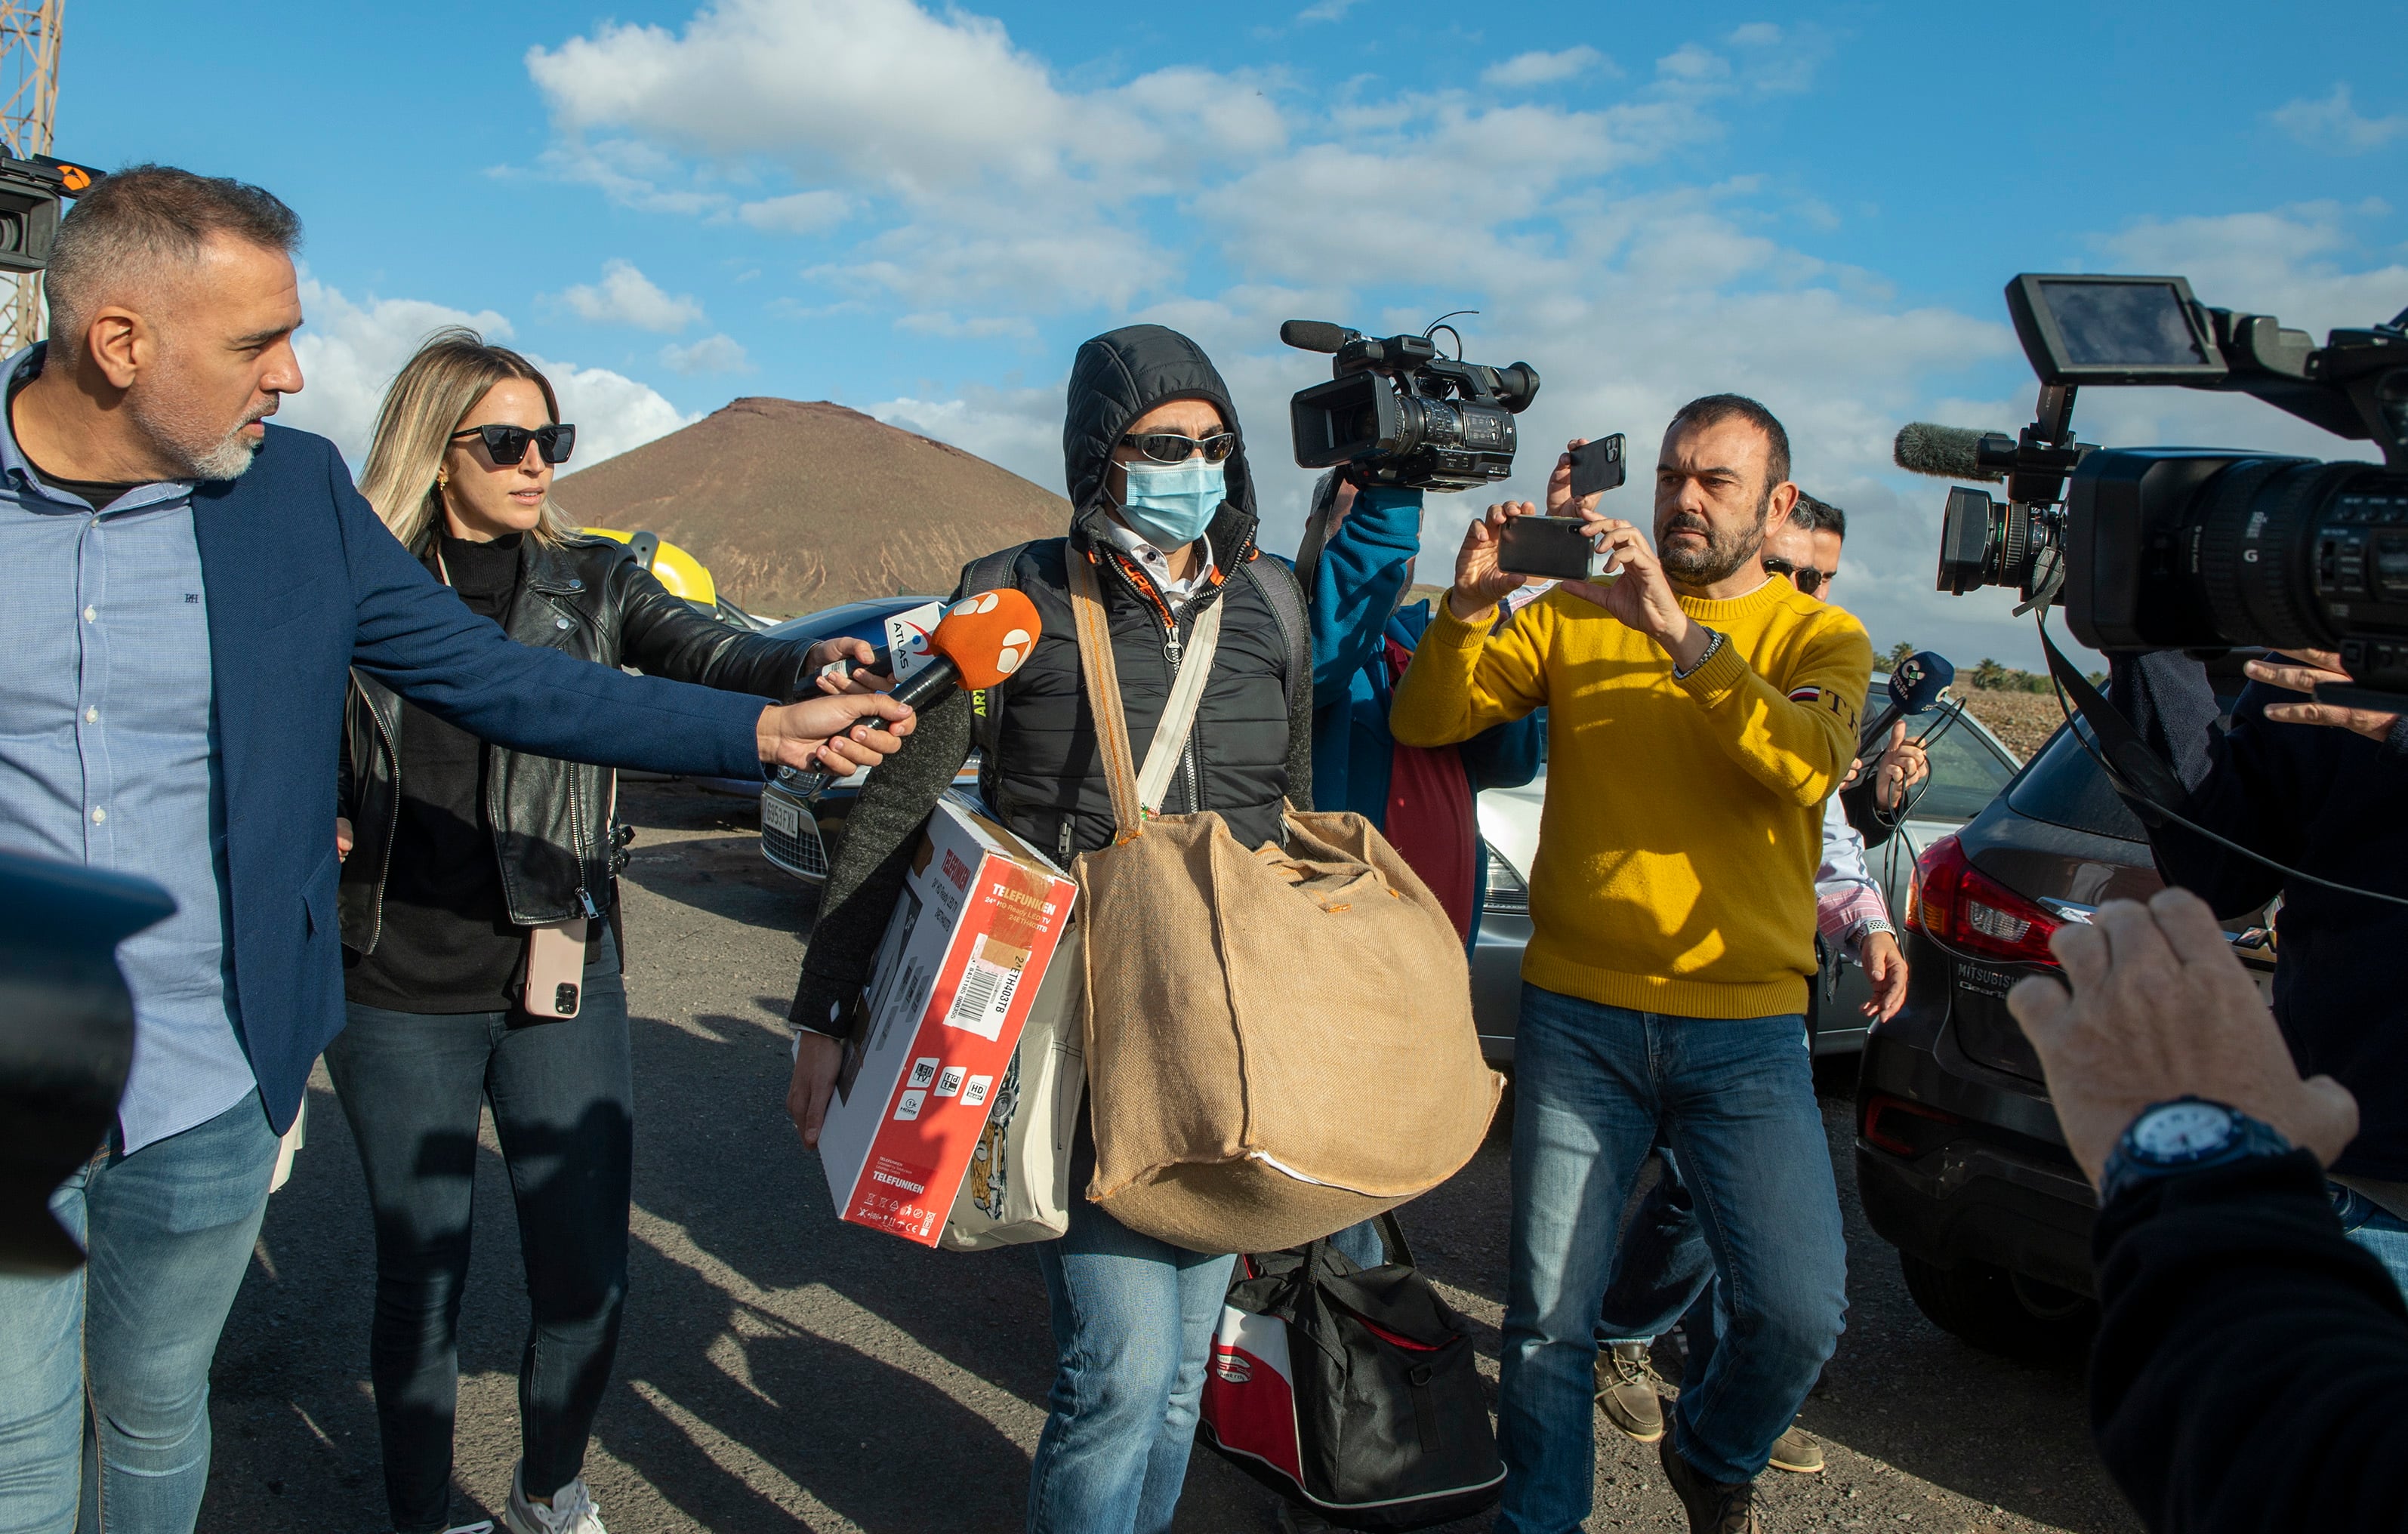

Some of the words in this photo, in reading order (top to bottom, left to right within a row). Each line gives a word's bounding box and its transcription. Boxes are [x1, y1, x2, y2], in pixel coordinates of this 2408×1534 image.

[894, 622, 909, 669] ATLAS
[941, 848, 972, 894] TELEFUNKEN
[992, 883, 1056, 916] TELEFUNKEN
[997, 900, 1007, 909] HD
[1007, 904, 1028, 916] Ready
[1027, 912, 1041, 920] LED
[1042, 916, 1051, 925] TV
[951, 996, 964, 1019] 000355
[917, 1064, 933, 1077] LED
[971, 1084, 984, 1094] HD
[873, 1170, 925, 1194] TELEFUNKEN
